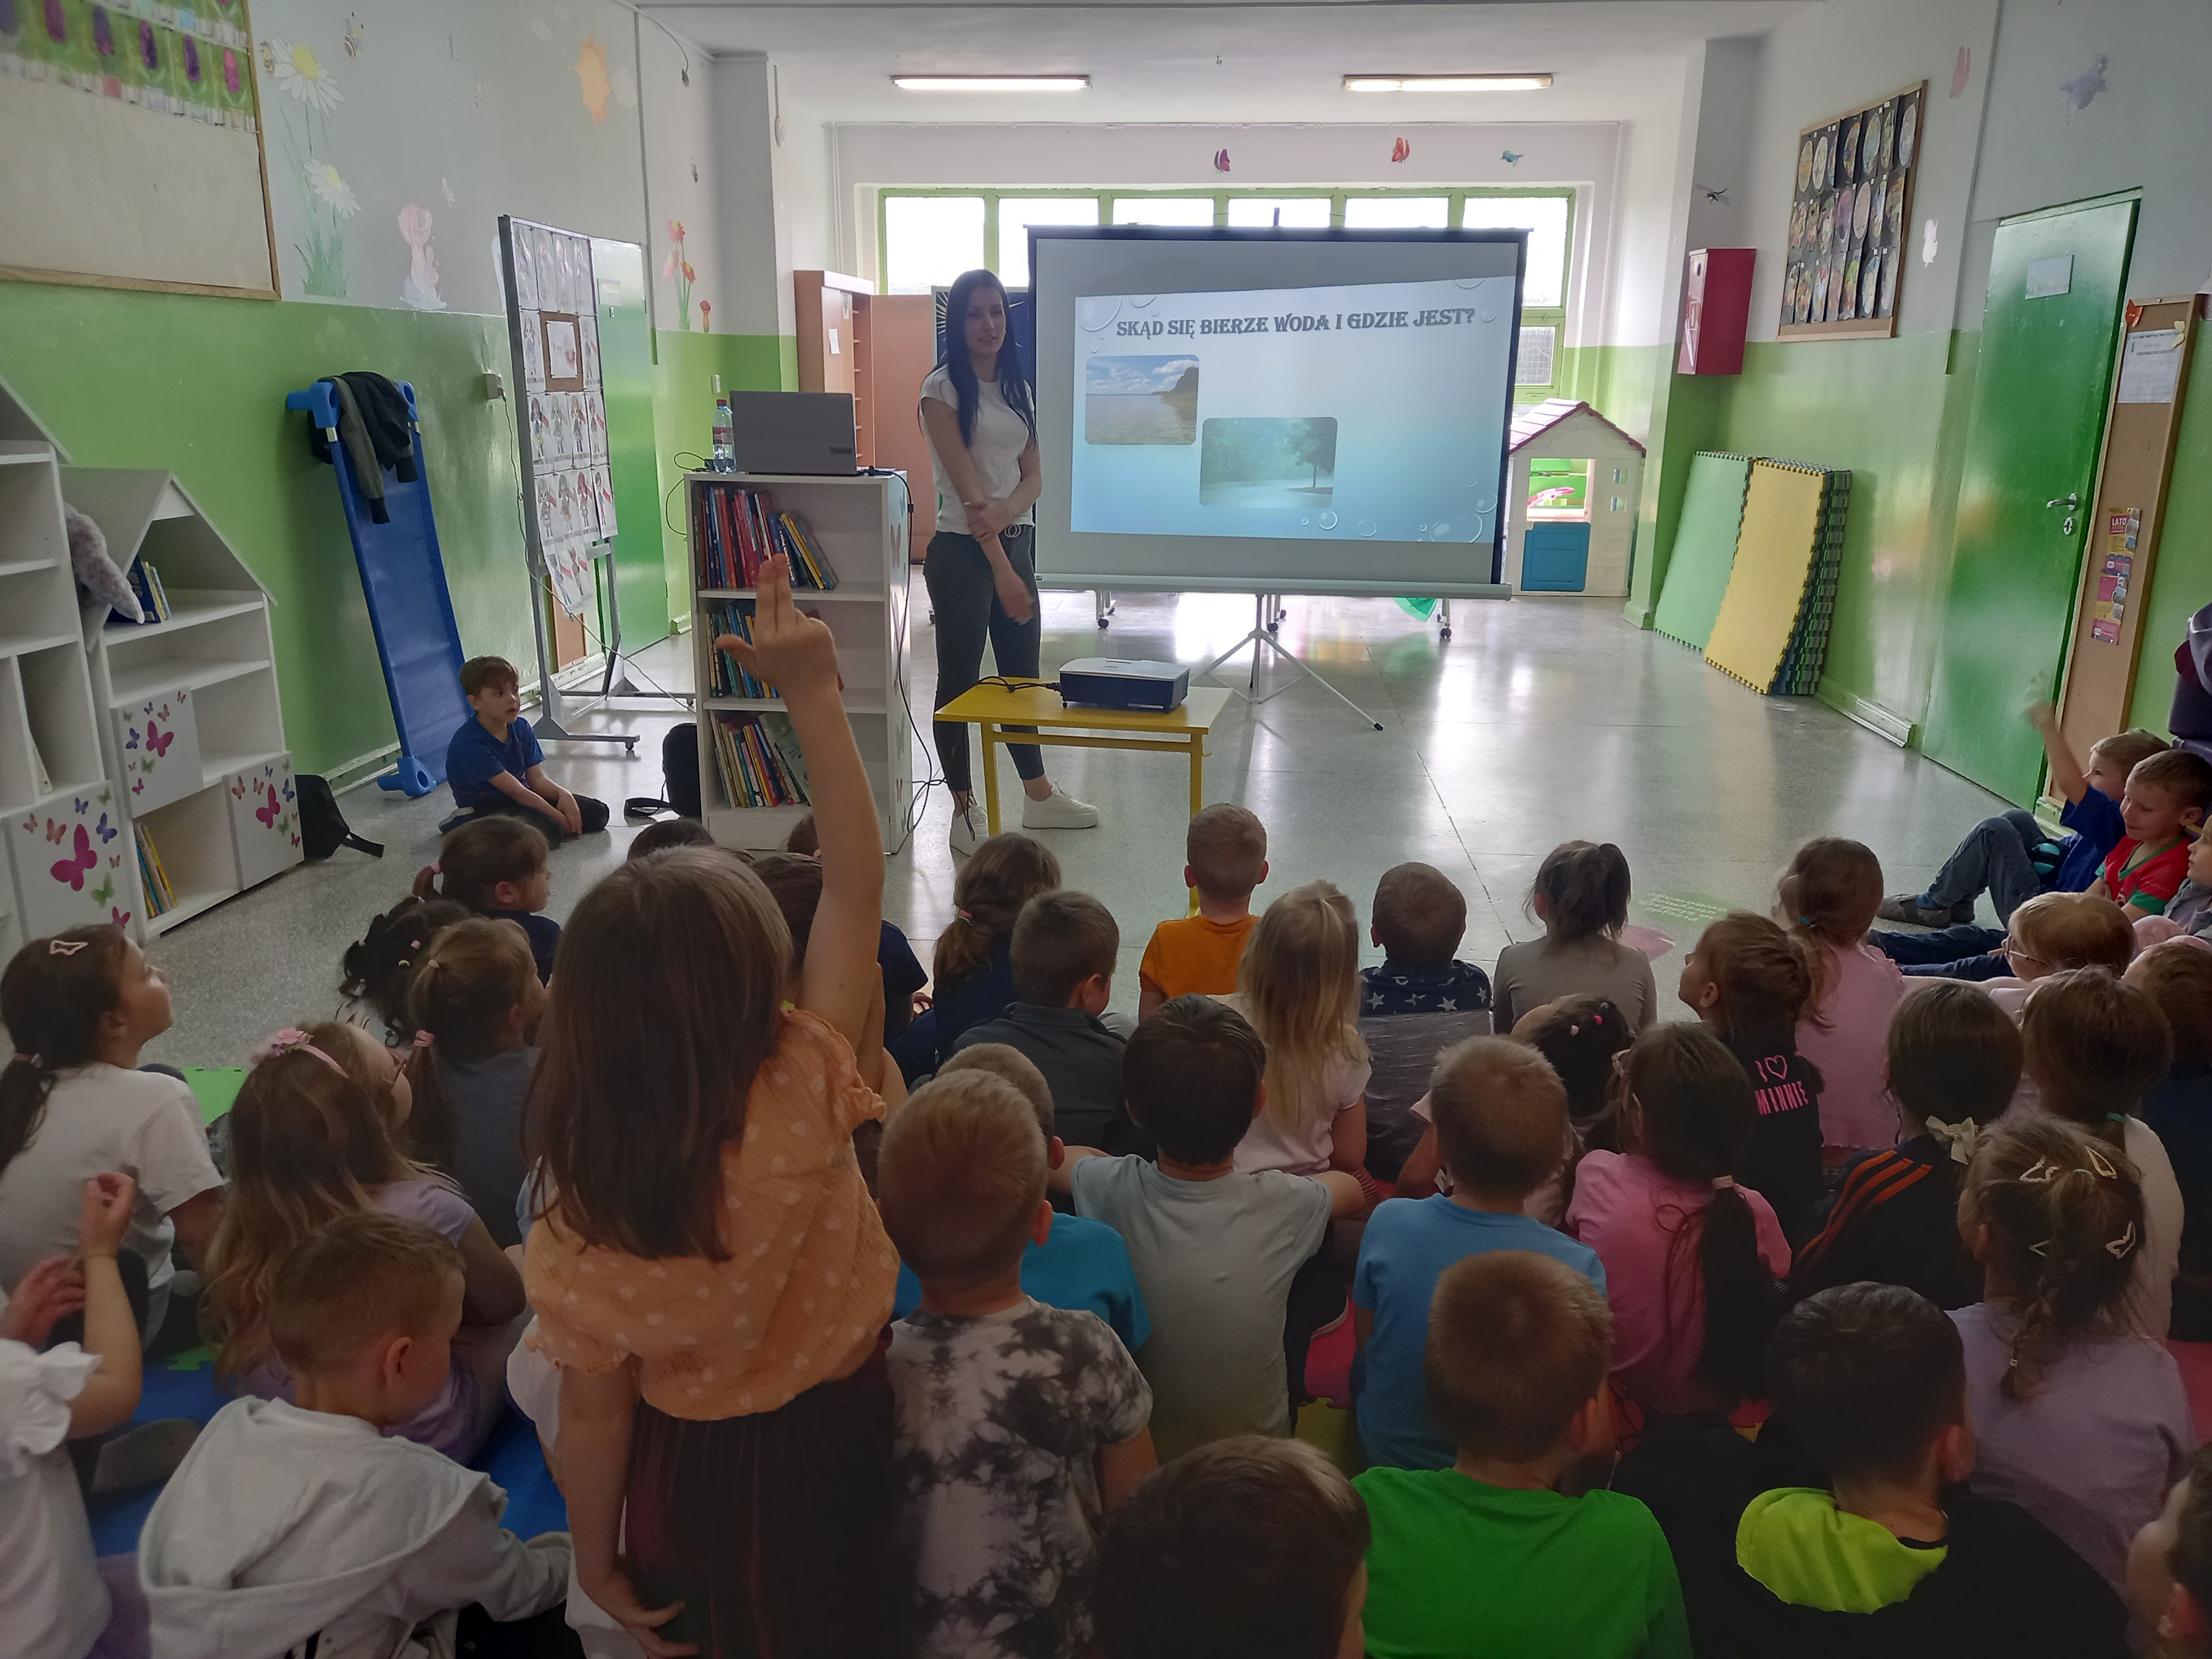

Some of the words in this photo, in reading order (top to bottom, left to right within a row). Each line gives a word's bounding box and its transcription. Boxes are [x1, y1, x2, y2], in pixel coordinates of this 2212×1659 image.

[1117, 321, 1164, 340] SKĄD
[1167, 320, 1195, 338] SIĘ
[1200, 317, 1269, 335] BIERZE
[1273, 312, 1331, 332] WODA
[1335, 314, 1343, 330] I
[1347, 311, 1409, 328] GDZIE
[1413, 308, 1476, 327] JEST?
[1754, 1060, 1768, 1083] I
[1755, 1081, 1809, 1115] MINNIE
